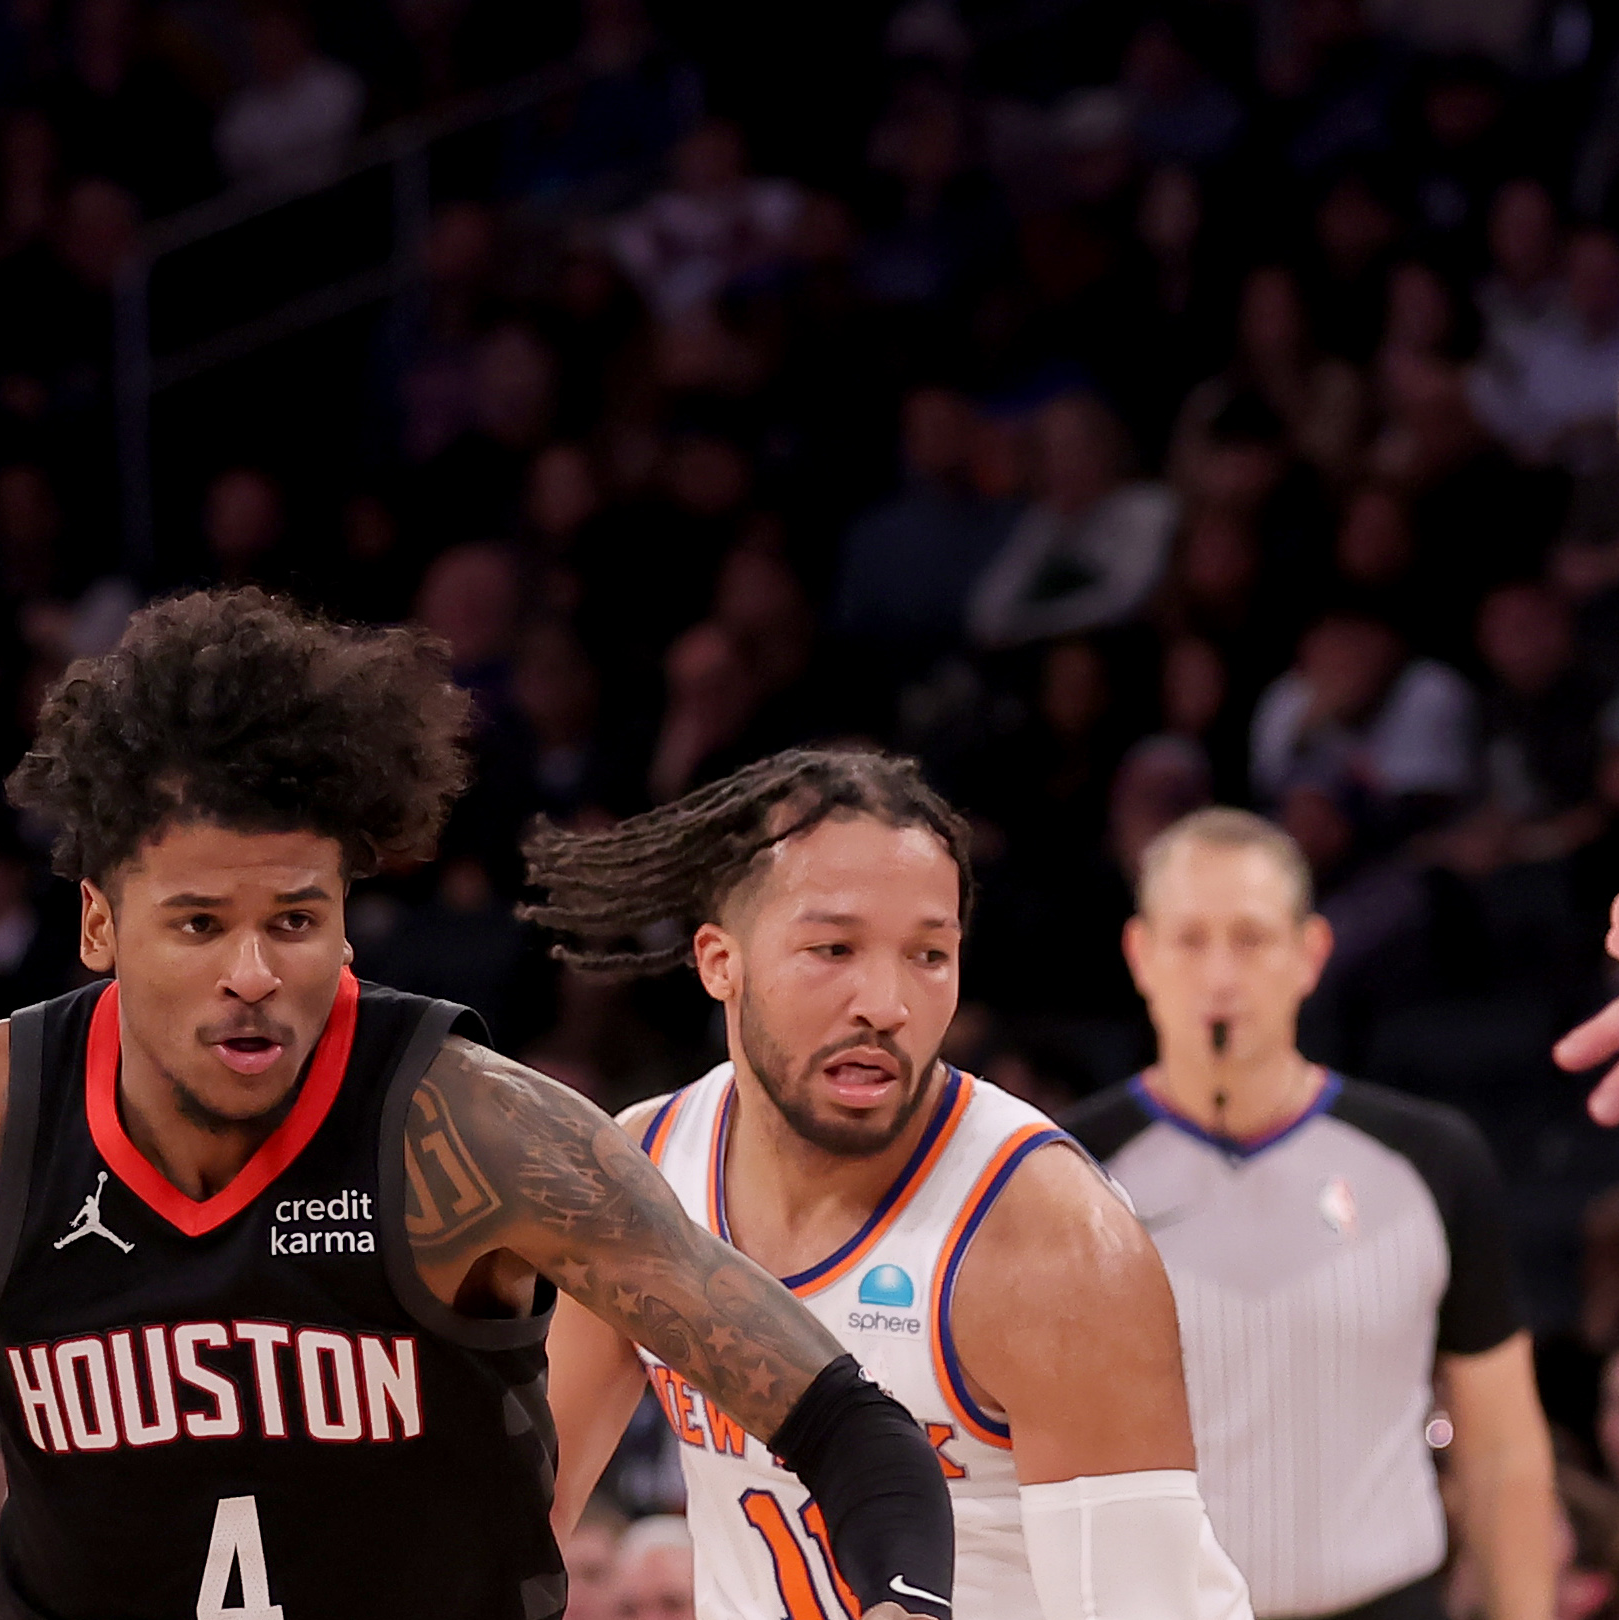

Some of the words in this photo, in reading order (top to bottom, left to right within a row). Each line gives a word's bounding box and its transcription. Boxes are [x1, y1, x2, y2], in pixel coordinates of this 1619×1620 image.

[274, 1189, 374, 1222] credit
[270, 1225, 376, 1256] karma
[847, 1311, 921, 1334] sphere
[7, 1318, 423, 1454] HOUSTON
